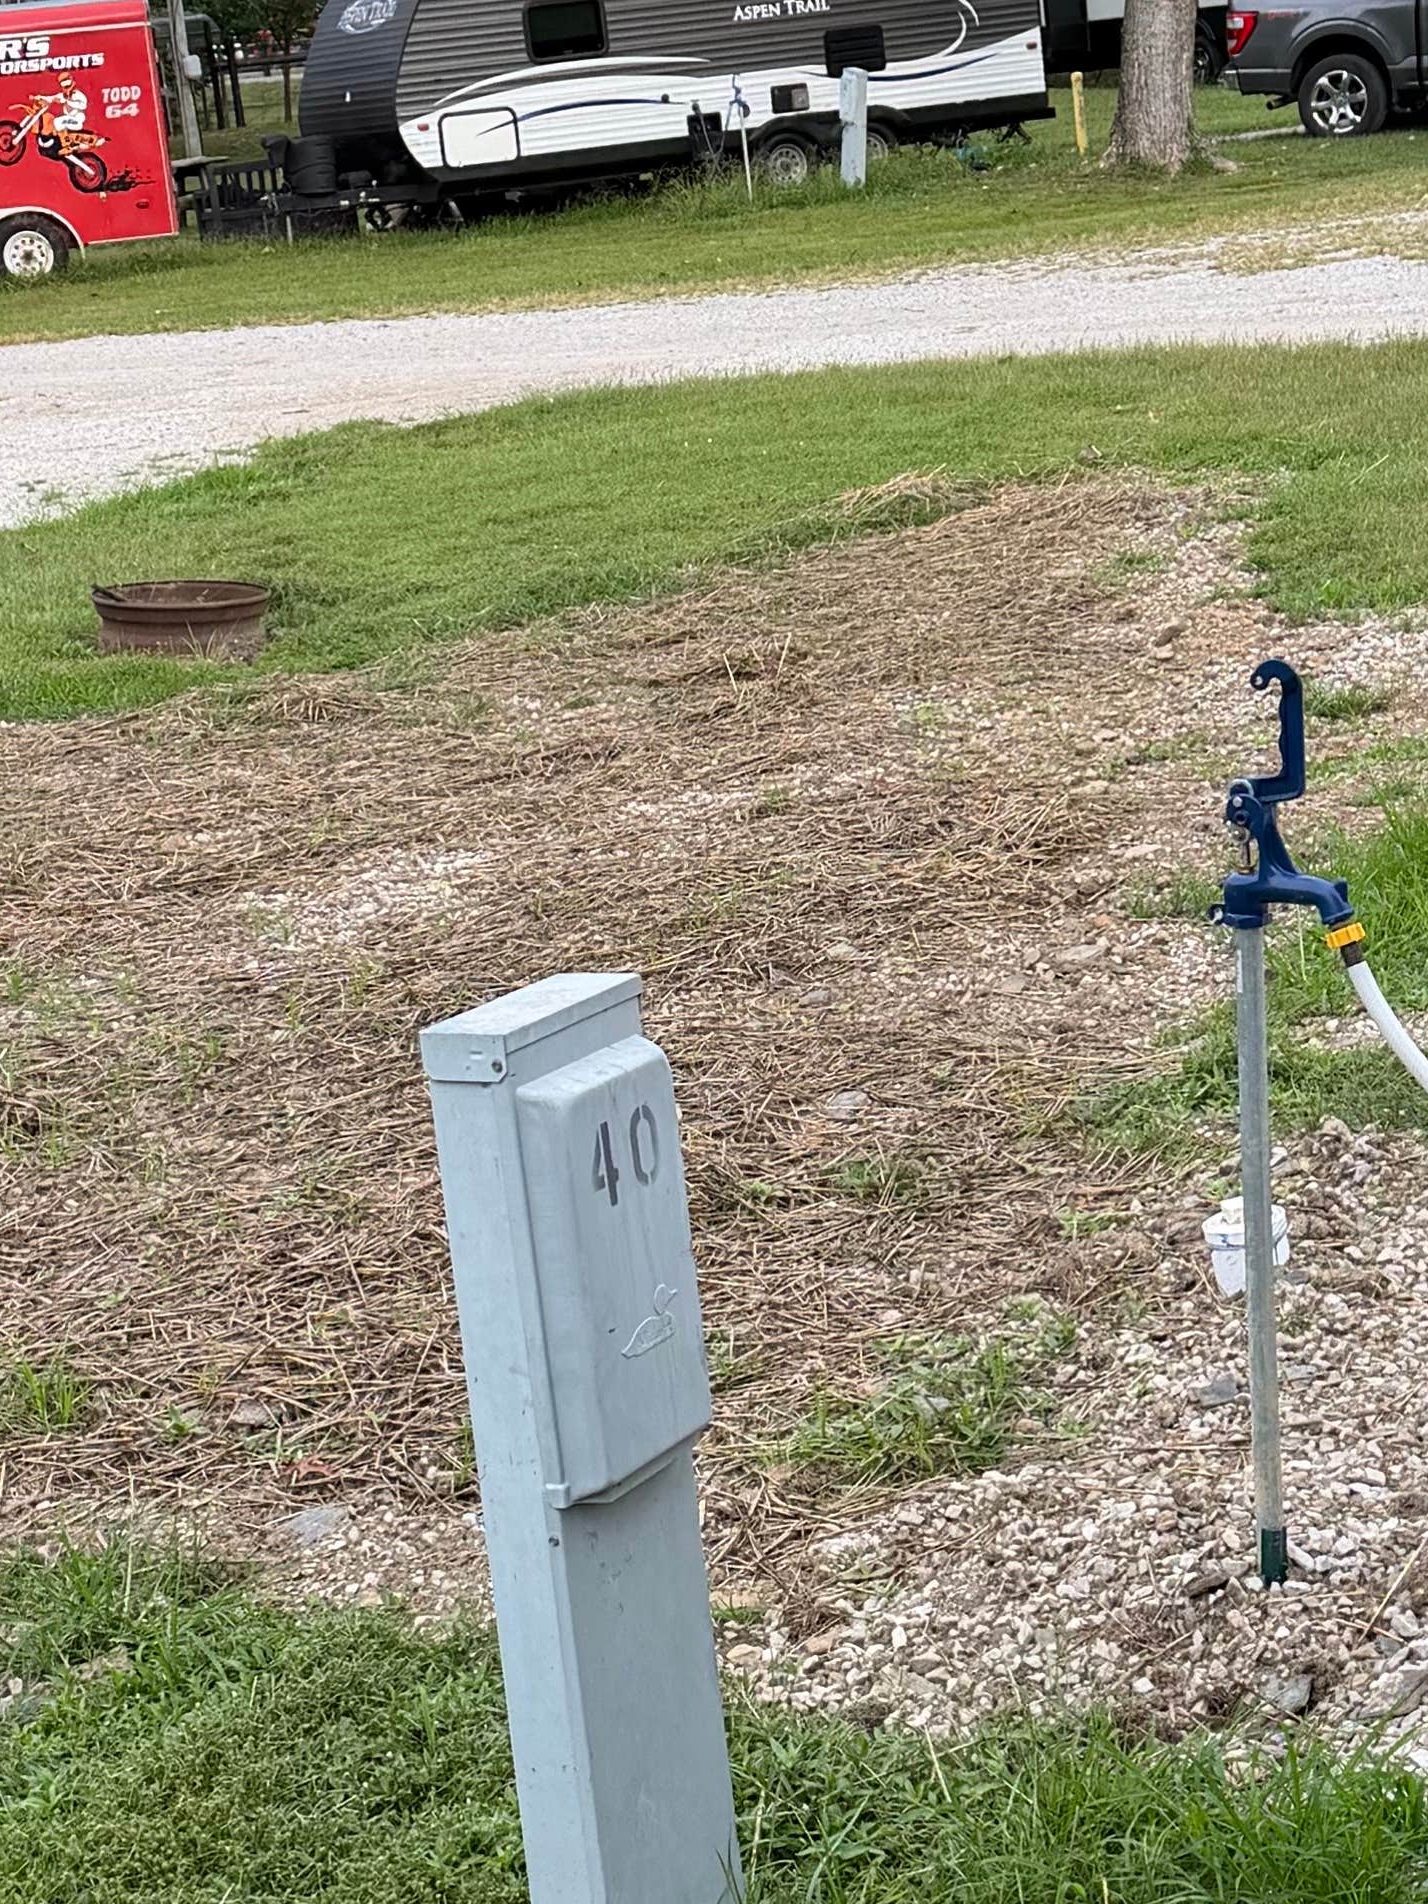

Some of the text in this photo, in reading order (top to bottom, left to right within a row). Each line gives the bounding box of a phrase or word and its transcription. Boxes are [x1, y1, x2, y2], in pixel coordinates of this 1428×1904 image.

[733, 3, 781, 21] ASPEN
[101, 85, 141, 104] TODD
[104, 103, 140, 119] 64
[592, 1104, 659, 1207] 40
